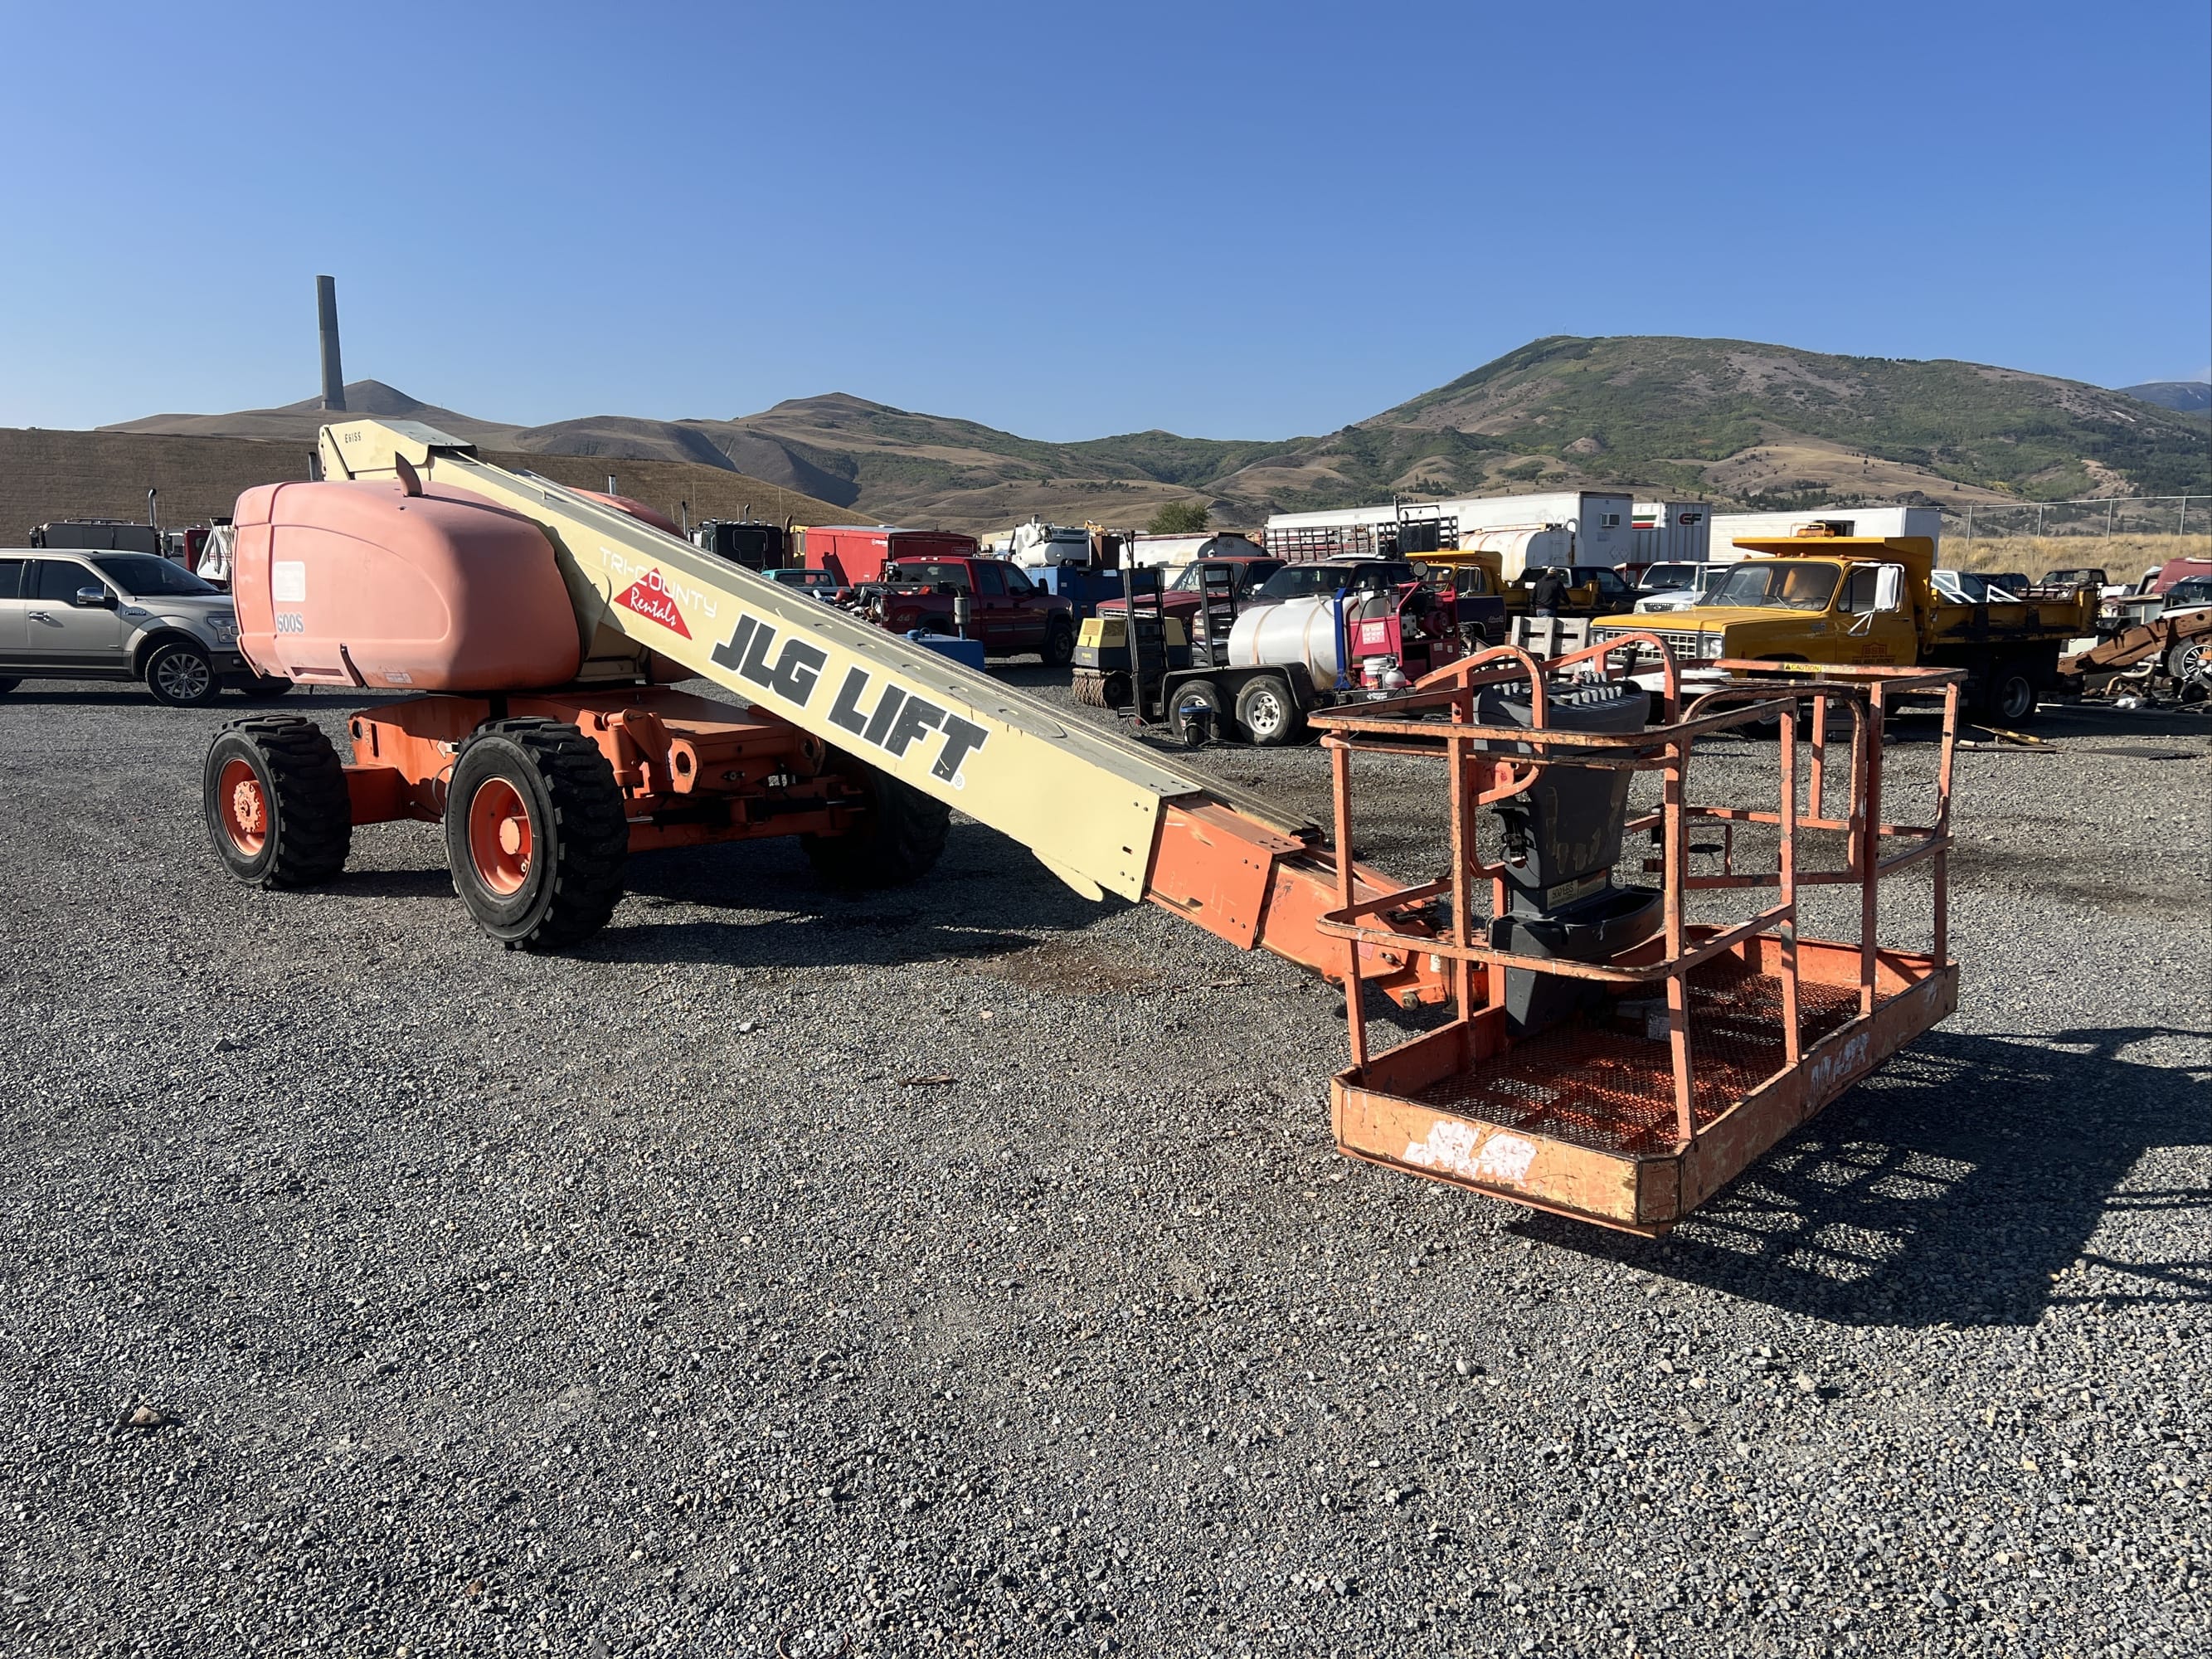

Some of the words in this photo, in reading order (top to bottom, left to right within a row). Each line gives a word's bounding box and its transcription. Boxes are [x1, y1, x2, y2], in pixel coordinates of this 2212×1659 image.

[599, 546, 717, 619] TRI-COUNTY
[630, 586, 677, 627] Rentals
[276, 612, 304, 633] 600S
[709, 612, 829, 709] JLG
[826, 664, 991, 784] LIFT
